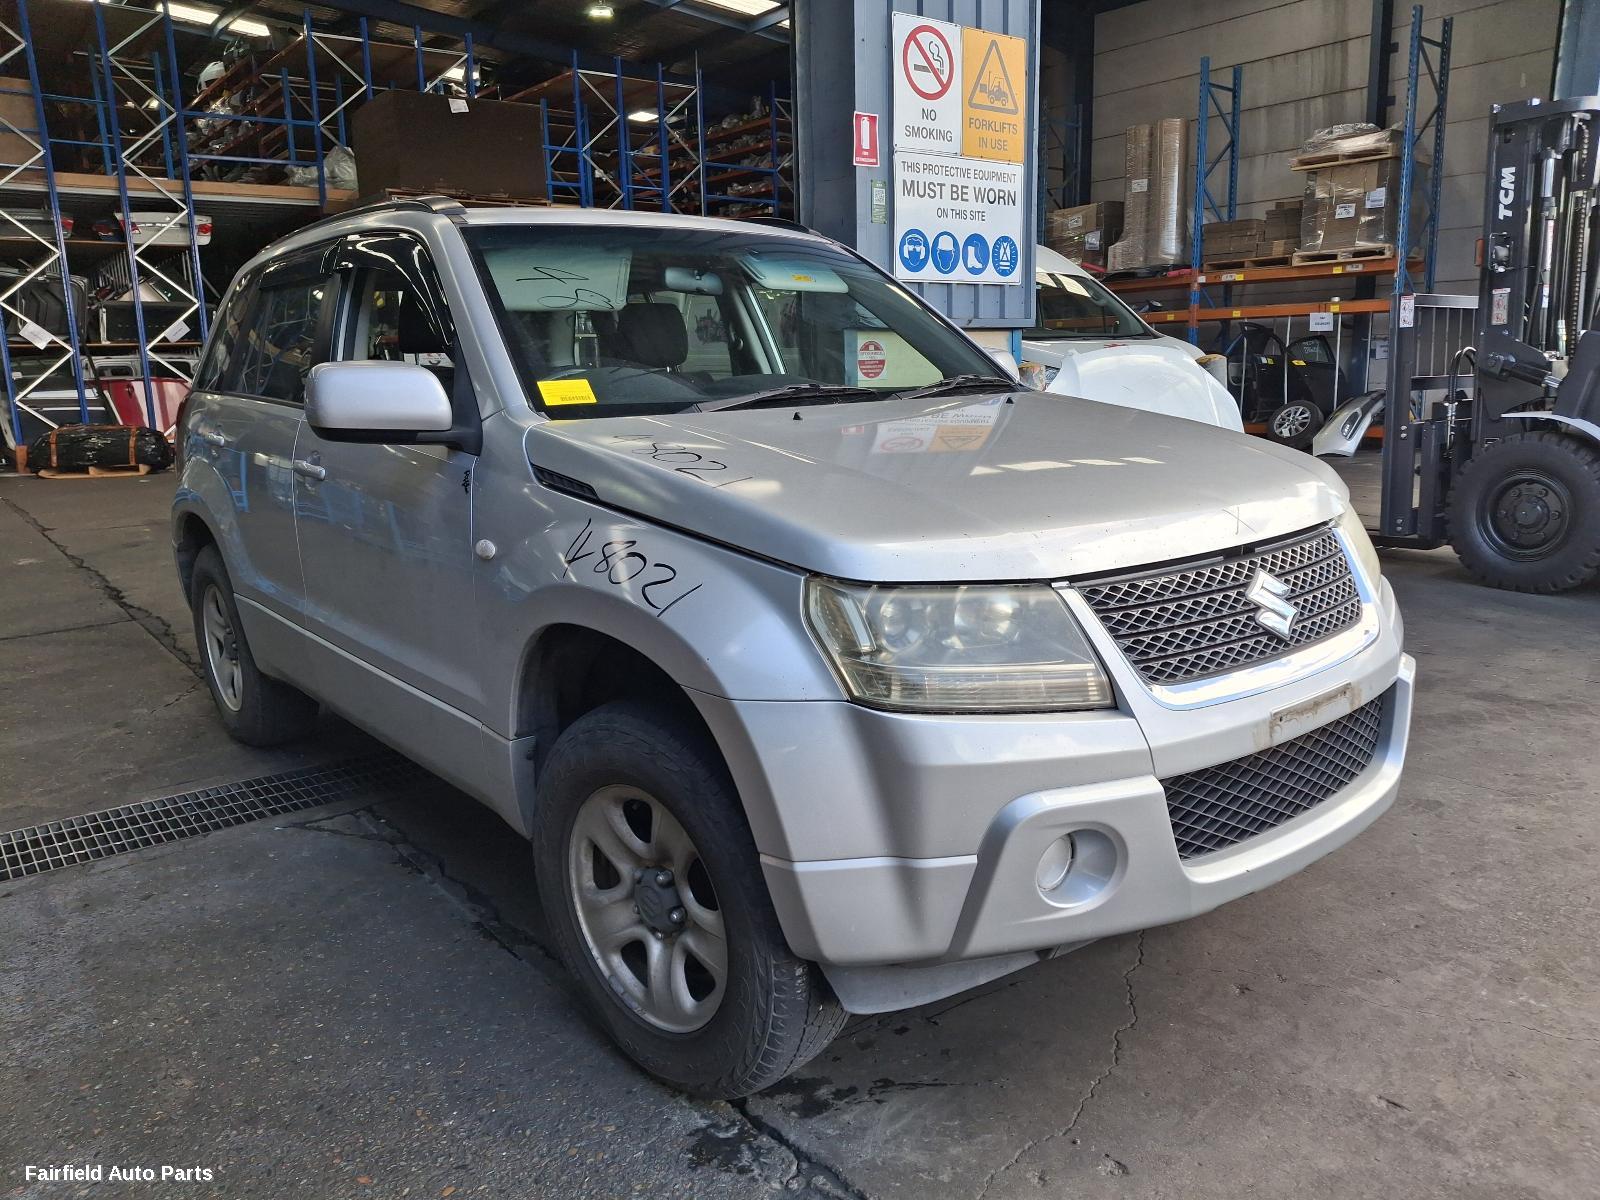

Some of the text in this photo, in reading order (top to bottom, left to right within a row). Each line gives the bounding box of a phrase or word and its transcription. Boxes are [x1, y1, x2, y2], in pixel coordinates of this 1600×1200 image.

[921, 108, 937, 121] NO
[904, 124, 953, 143] SMOKING
[968, 117, 1018, 135] FORKLIFTS
[978, 137, 1008, 151] IN USE
[901, 161, 1017, 184] THIS PROTECTIVE EQUIPMENT
[902, 179, 1017, 206] MUST BE WORN
[1498, 166, 1516, 220] TCM
[936, 207, 986, 222] ON THIS SITE
